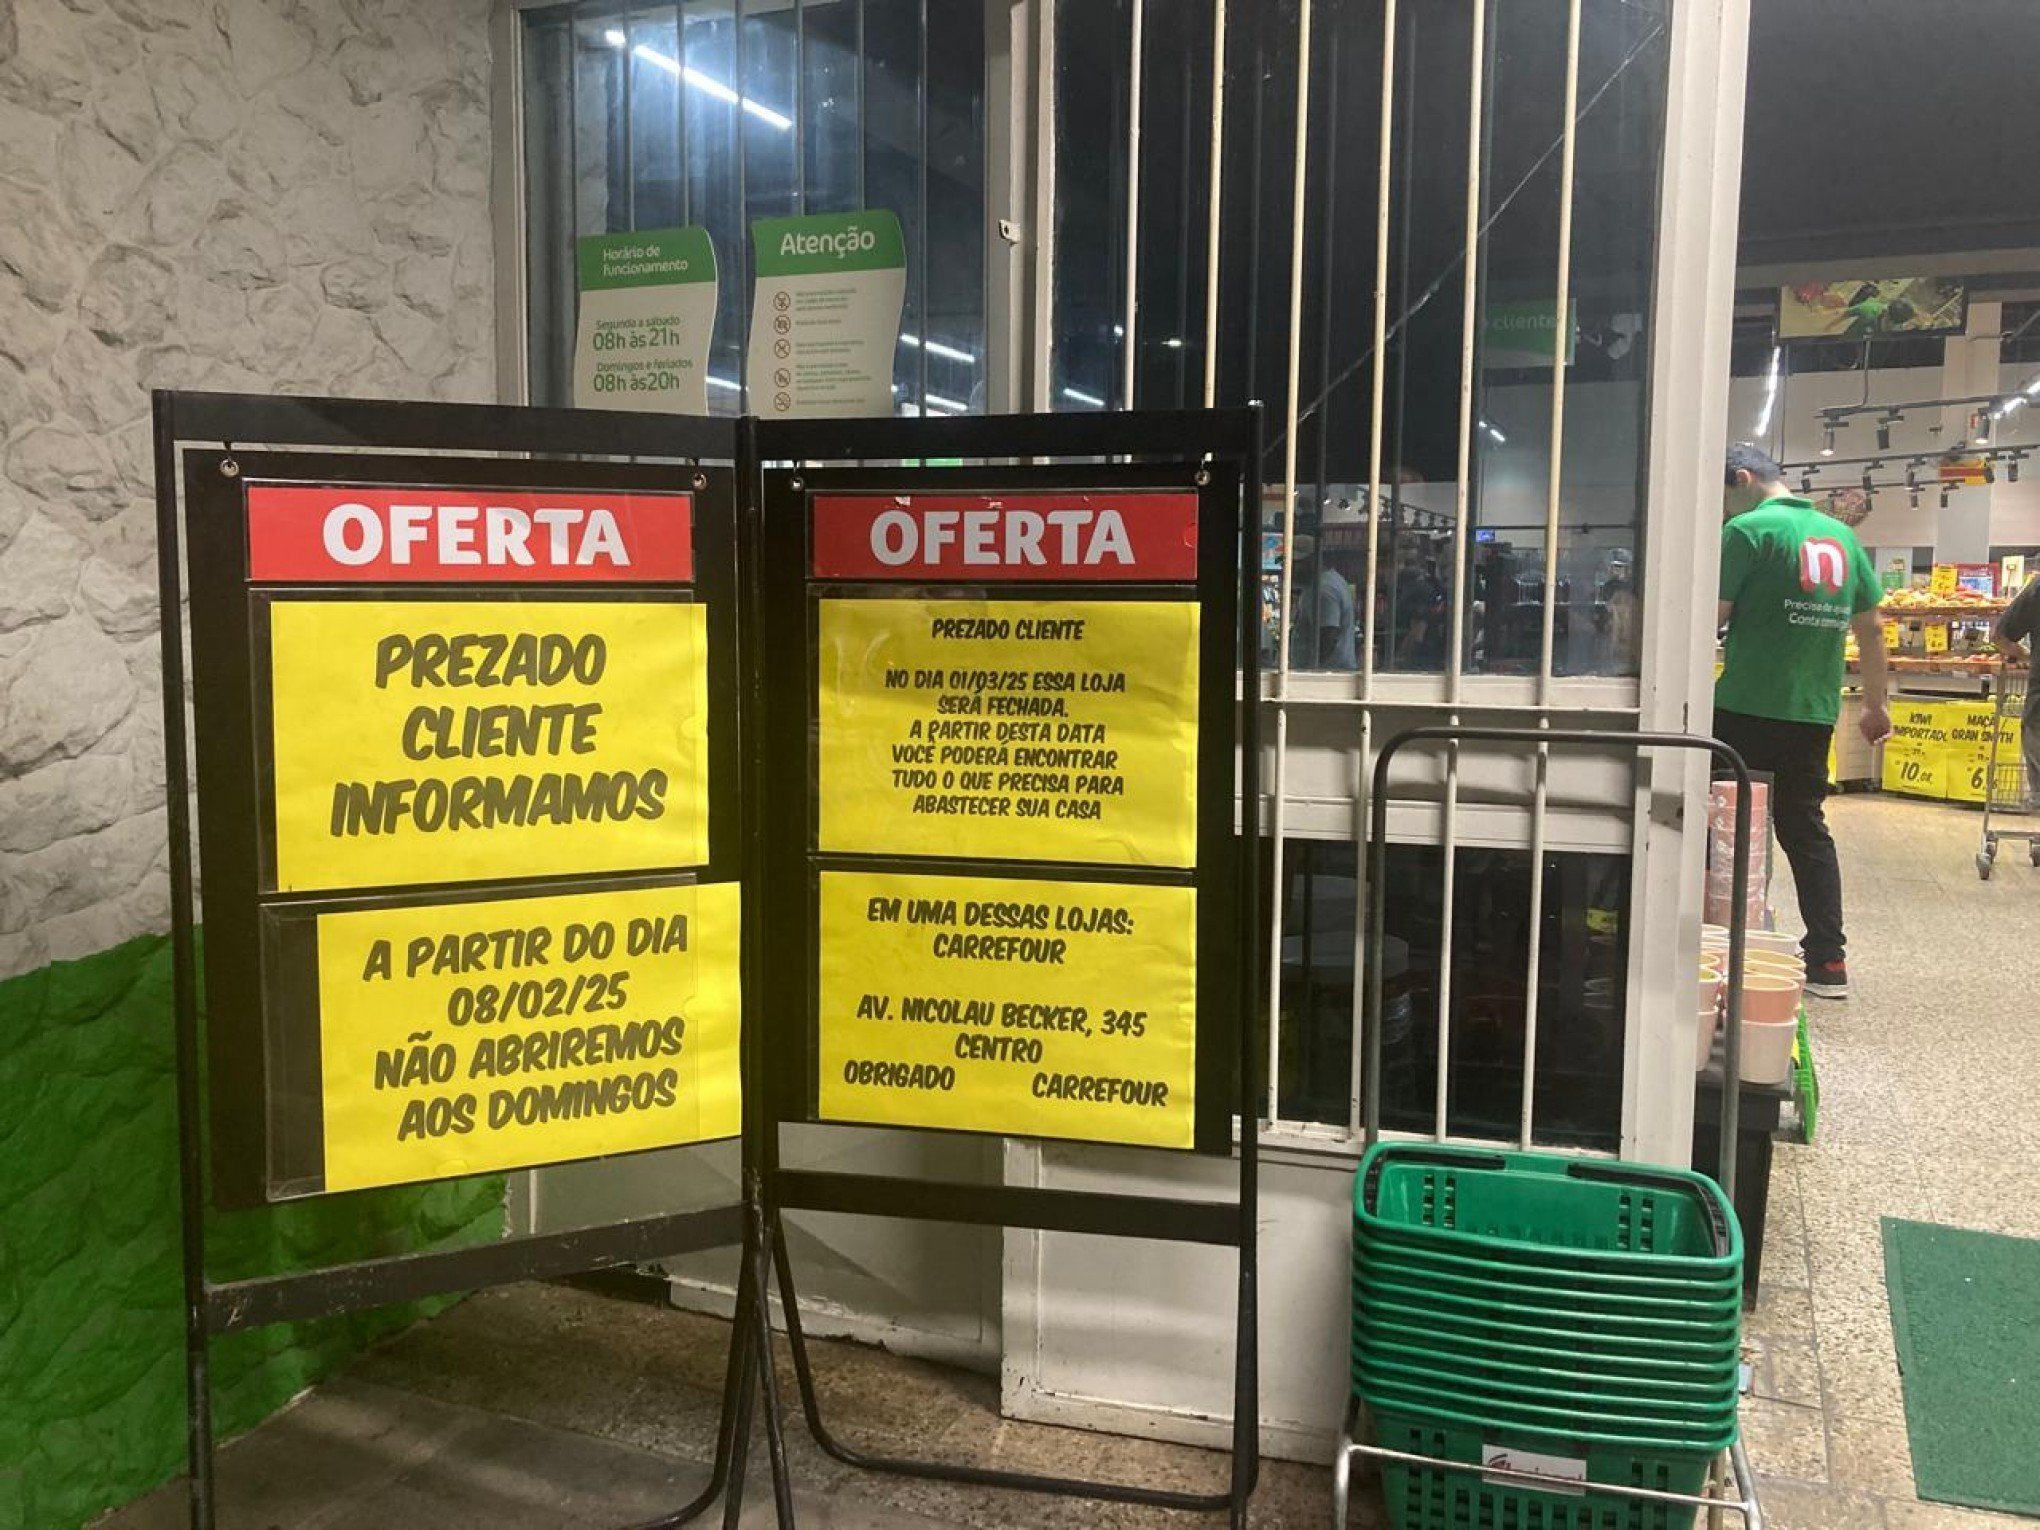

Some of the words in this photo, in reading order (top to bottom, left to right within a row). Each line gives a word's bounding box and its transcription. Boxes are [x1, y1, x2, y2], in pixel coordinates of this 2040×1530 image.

[603, 246, 644, 261] Horário
[646, 245, 661, 258] de
[781, 226, 876, 259] Atenção
[592, 331, 626, 352] 08h
[649, 326, 680, 347] 21h
[596, 318, 637, 333] Segunda
[593, 373, 627, 393] 08h
[648, 370, 680, 391] 20h
[596, 359, 645, 374] Domingos
[323, 503, 631, 566] OFERTA
[869, 508, 1136, 566] OFERTA
[931, 619, 1010, 640] PREZADO
[1015, 619, 1085, 641] CLIENTE
[374, 632, 607, 689] PREZADO
[885, 670, 909, 690] NO
[915, 670, 945, 690] DIA
[949, 671, 1028, 692] 01/03/25
[1032, 672, 1075, 692] ESSA
[1081, 673, 1126, 693] LOJA
[937, 686, 982, 716] SERÁ
[987, 696, 1069, 718] FECHADA.
[402, 702, 604, 761] CLIENTE
[909, 720, 922, 739] A
[927, 721, 991, 743] PARTIR
[996, 722, 1051, 743] DESTA
[1057, 723, 1106, 744] DATA
[892, 737, 936, 764] VOCÊ
[940, 740, 1009, 766] PODERÁ
[1014, 747, 1118, 770] ENCONTRAR
[892, 769, 937, 790] TUDO
[942, 770, 954, 790] O
[960, 771, 993, 791] QUE
[998, 772, 1069, 794] PRECISA
[1075, 774, 1124, 796] PARA
[330, 768, 669, 838] INFORMAMOS
[913, 795, 1009, 817] ABASTECER
[1016, 798, 1050, 819] SUA
[1055, 799, 1101, 820] CASA
[867, 896, 902, 923] EM
[907, 898, 957, 926] UMA
[963, 901, 1050, 931] DESSAS
[1055, 906, 1134, 935] LOJAS:
[362, 939, 392, 981] A
[406, 925, 553, 978] PARTIR
[563, 921, 615, 963] DO
[627, 914, 688, 957] DIA
[933, 933, 1067, 965] CARREFOUR
[447, 970, 630, 1027] 08/02/25
[856, 994, 895, 1021] AV.
[901, 996, 996, 1026] NICOLAU
[1001, 1002, 1093, 1038] BECKER,
[1100, 1009, 1147, 1037] 345
[373, 1030, 456, 1090] NÃO
[467, 1016, 686, 1080] ABRIREMOS
[954, 1032, 1043, 1064] CENTRO
[843, 1060, 956, 1091] OBRIGADO
[1031, 1072, 1169, 1107] CARREFOUR
[397, 1094, 477, 1142] AOS
[487, 1067, 679, 1131] DOMINGOS
